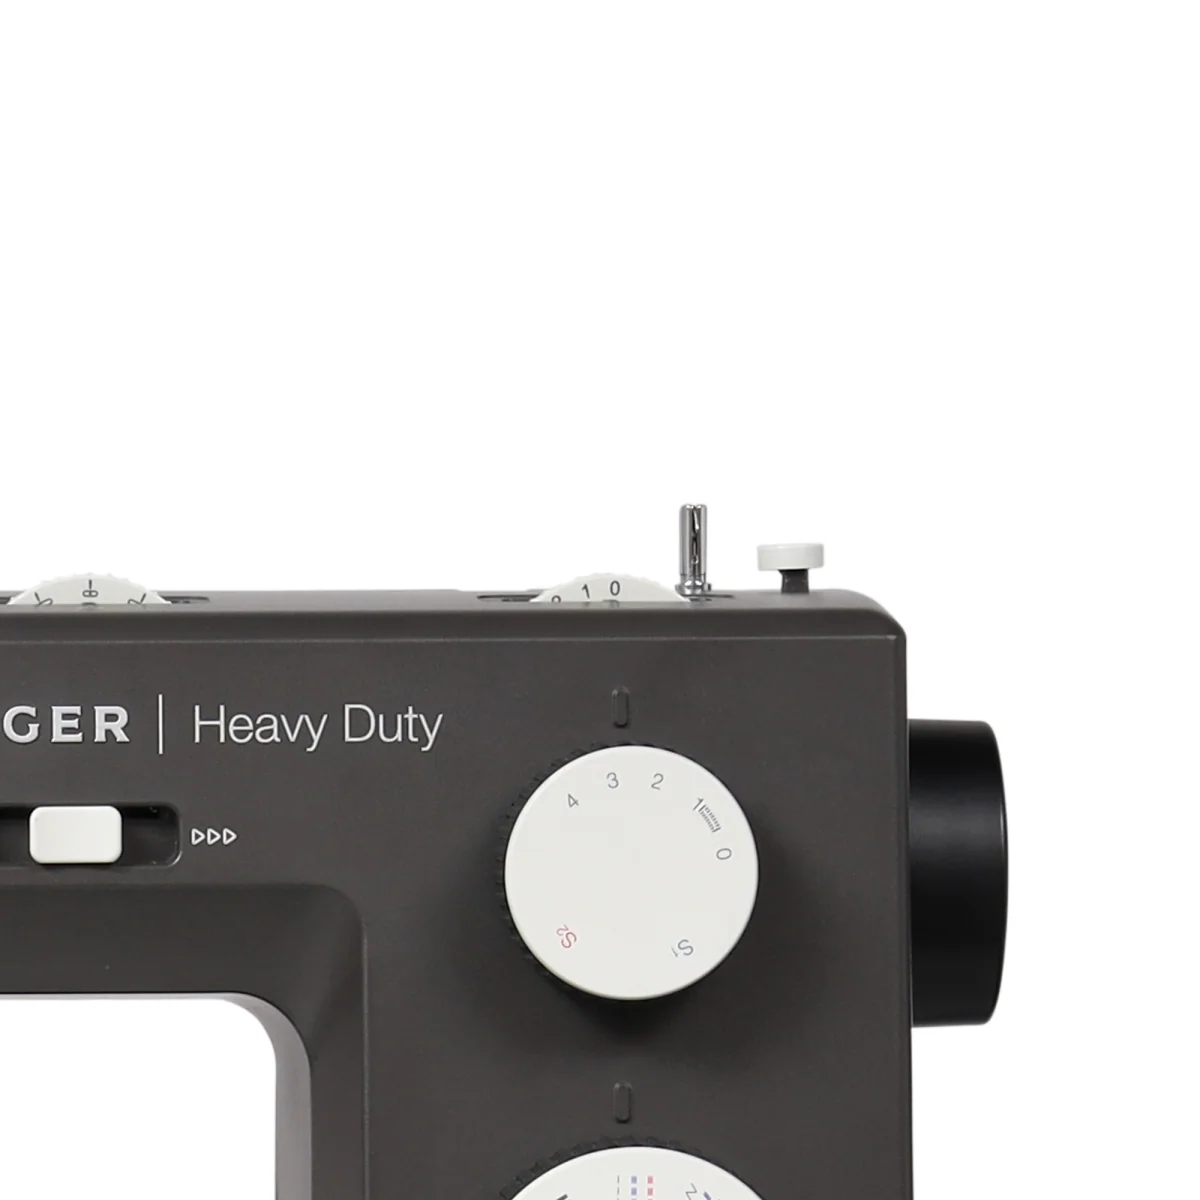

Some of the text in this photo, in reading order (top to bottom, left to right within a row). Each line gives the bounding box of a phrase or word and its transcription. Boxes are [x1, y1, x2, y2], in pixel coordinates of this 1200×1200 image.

[581, 583, 591, 599] 1
[609, 580, 621, 597] 0
[193, 703, 329, 753] Heavy
[343, 703, 444, 752] Duty
[567, 793, 580, 809] 4
[605, 771, 620, 789] 3
[650, 772, 665, 791] 2
[716, 847, 733, 861] 0
